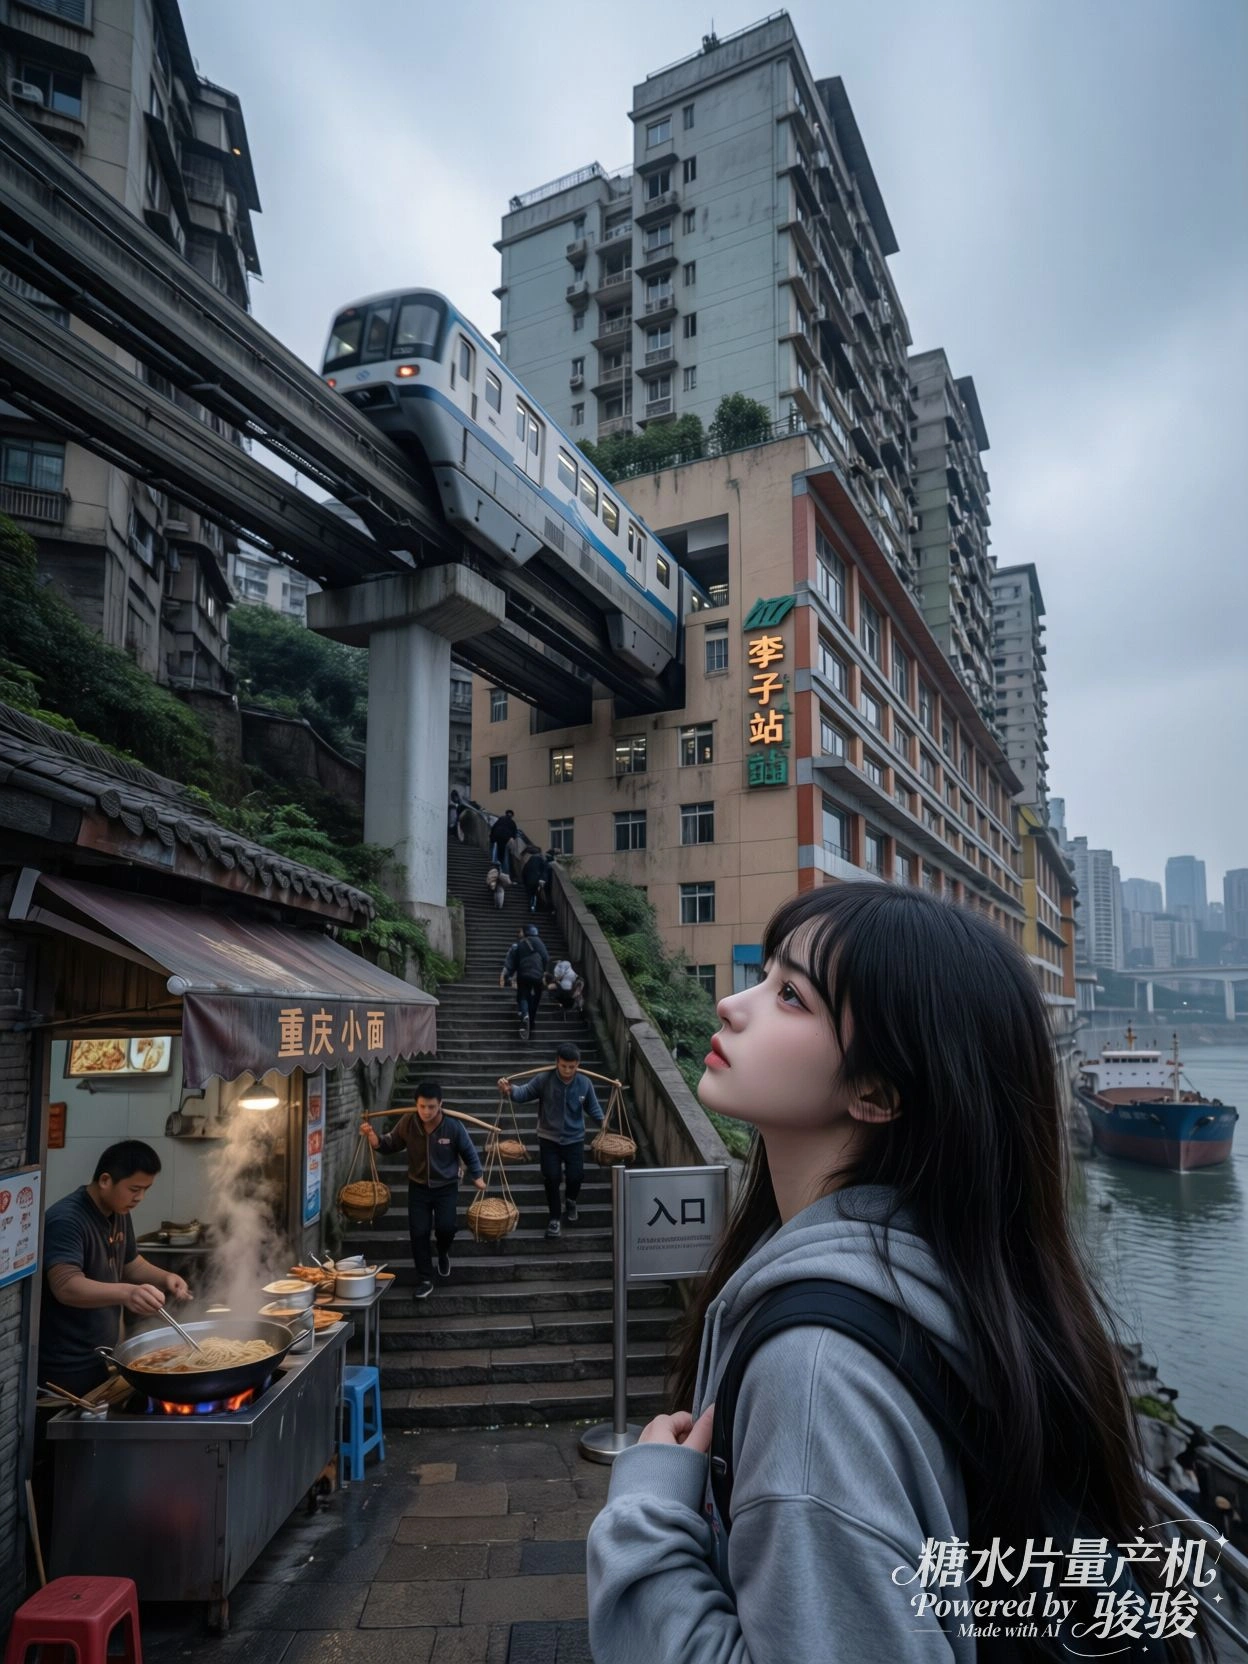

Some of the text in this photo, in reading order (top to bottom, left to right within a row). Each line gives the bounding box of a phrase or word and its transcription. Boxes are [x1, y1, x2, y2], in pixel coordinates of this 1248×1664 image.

[748, 635, 784, 744] 李子站
[278, 1007, 385, 1058] 重庆小面
[646, 1197, 706, 1227] 入口
